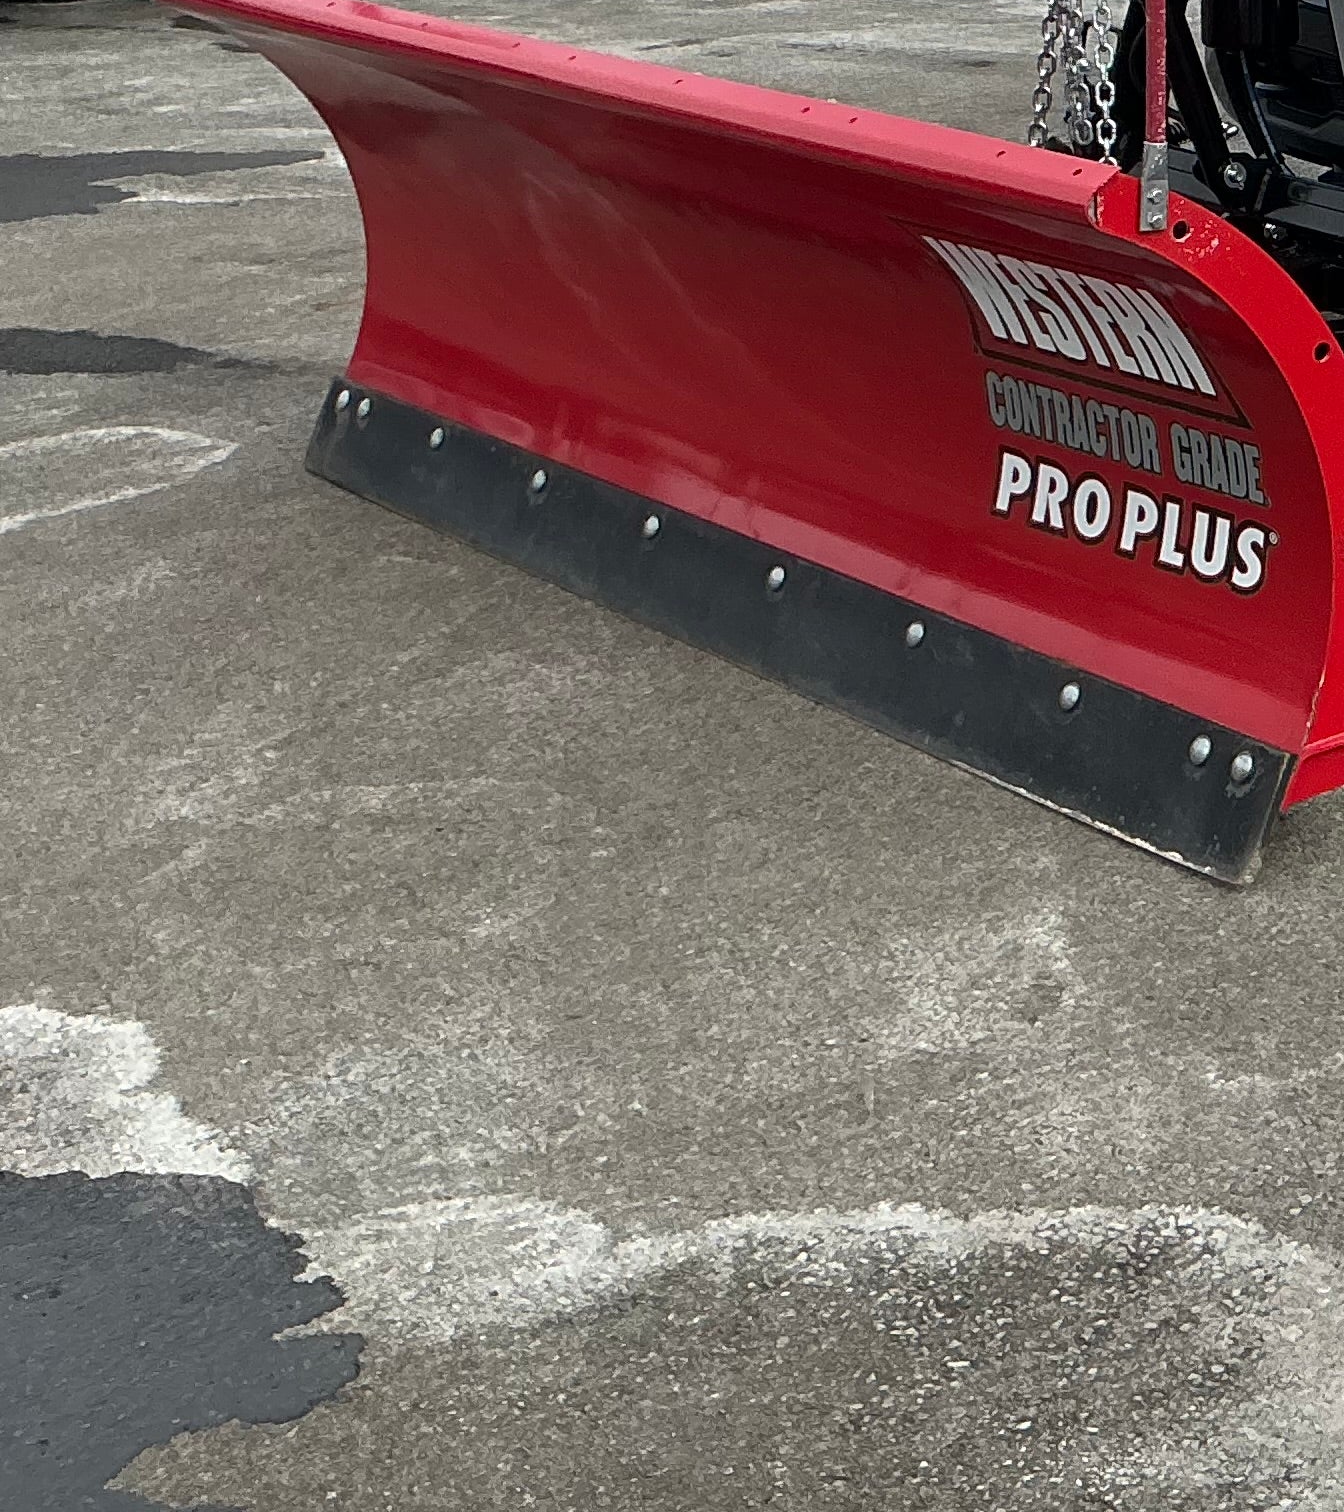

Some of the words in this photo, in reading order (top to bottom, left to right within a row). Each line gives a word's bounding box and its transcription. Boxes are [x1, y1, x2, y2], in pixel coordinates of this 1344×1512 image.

[922, 236, 1217, 396] WESTERN
[985, 371, 1161, 475] CONTRACTOR
[1170, 424, 1266, 505] GRADE
